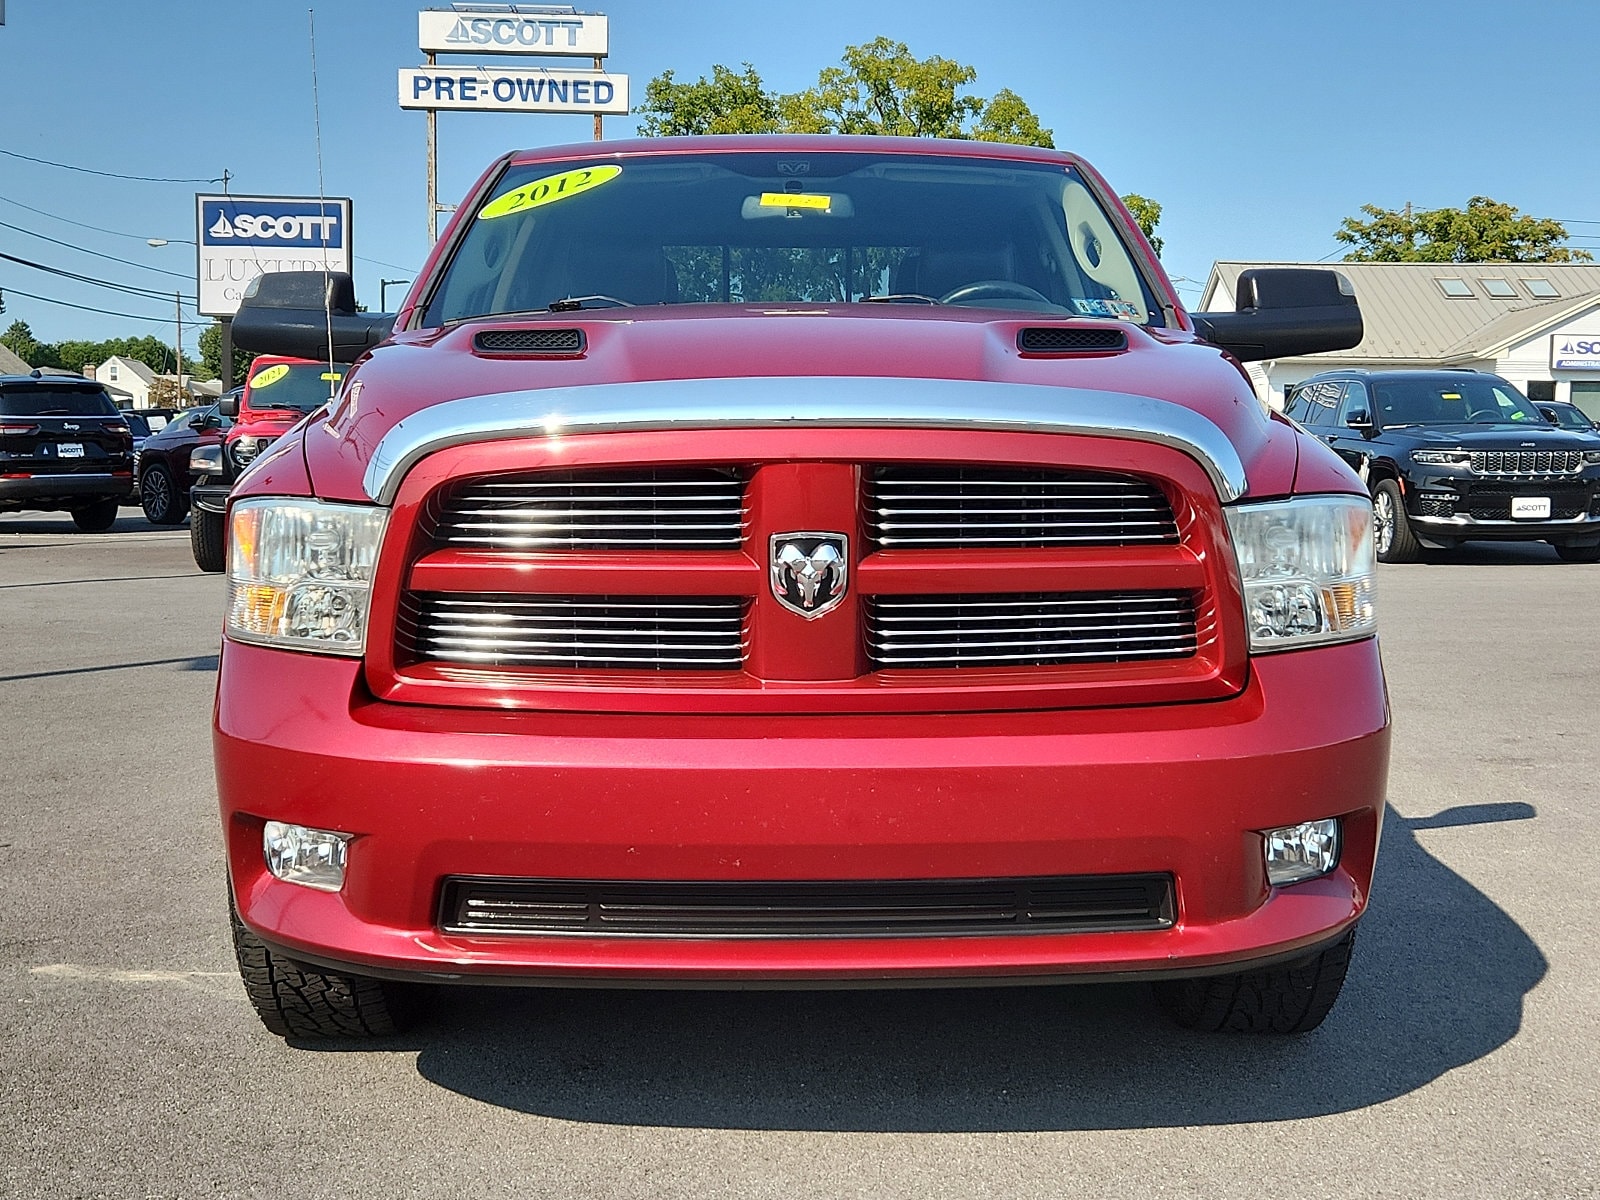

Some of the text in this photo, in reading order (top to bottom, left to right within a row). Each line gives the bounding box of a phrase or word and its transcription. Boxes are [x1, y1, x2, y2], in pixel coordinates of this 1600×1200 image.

[470, 18, 583, 46] SCOTT
[413, 75, 614, 105] PRE-OWNED
[507, 171, 593, 211] 2012
[233, 214, 337, 239] SCOTT
[63, 422, 80, 430] Jeep
